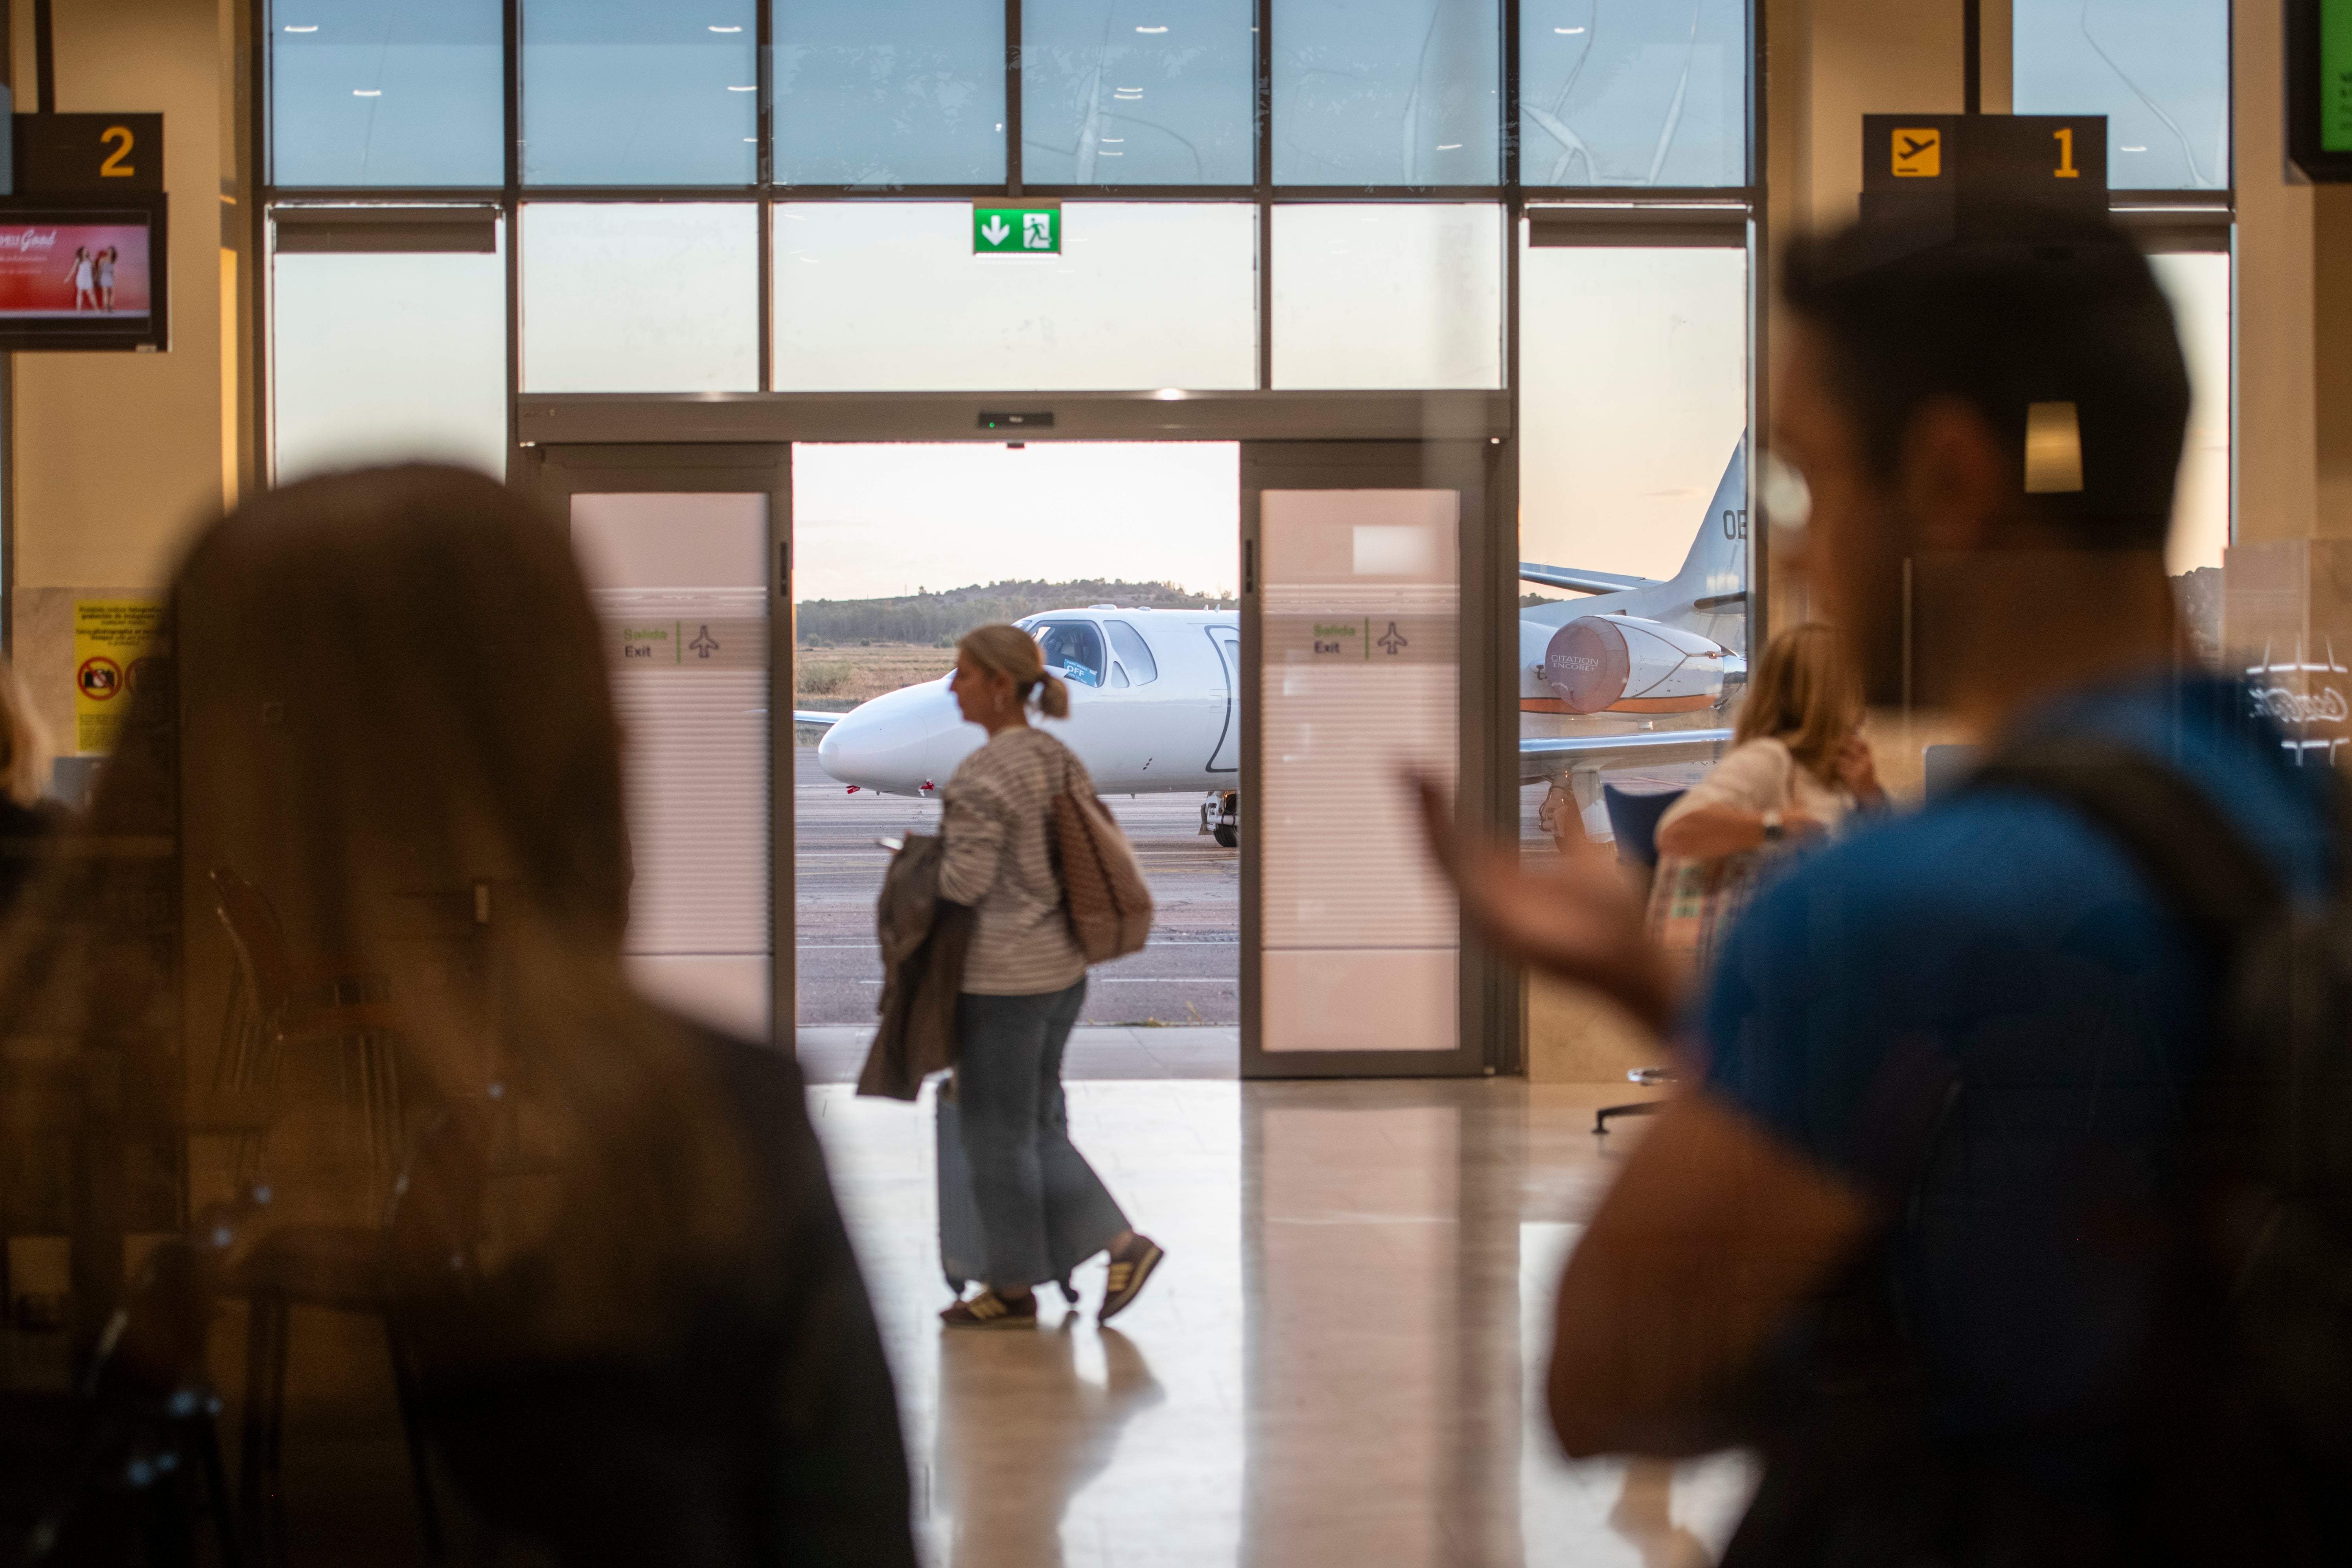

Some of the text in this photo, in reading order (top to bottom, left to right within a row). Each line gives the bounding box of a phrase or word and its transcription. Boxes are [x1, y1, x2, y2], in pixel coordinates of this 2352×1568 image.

[101, 125, 134, 177] 2
[2054, 128, 2079, 177] 1
[21, 229, 57, 252] Good
[624, 629, 667, 640] Salida
[1314, 624, 1355, 636] Salida
[625, 645, 651, 658] Exit
[1314, 641, 1340, 653] Exit
[1551, 655, 1598, 665] CITATION
[1067, 665, 1084, 676] OFF
[1553, 663, 1595, 671] ENCORE+
